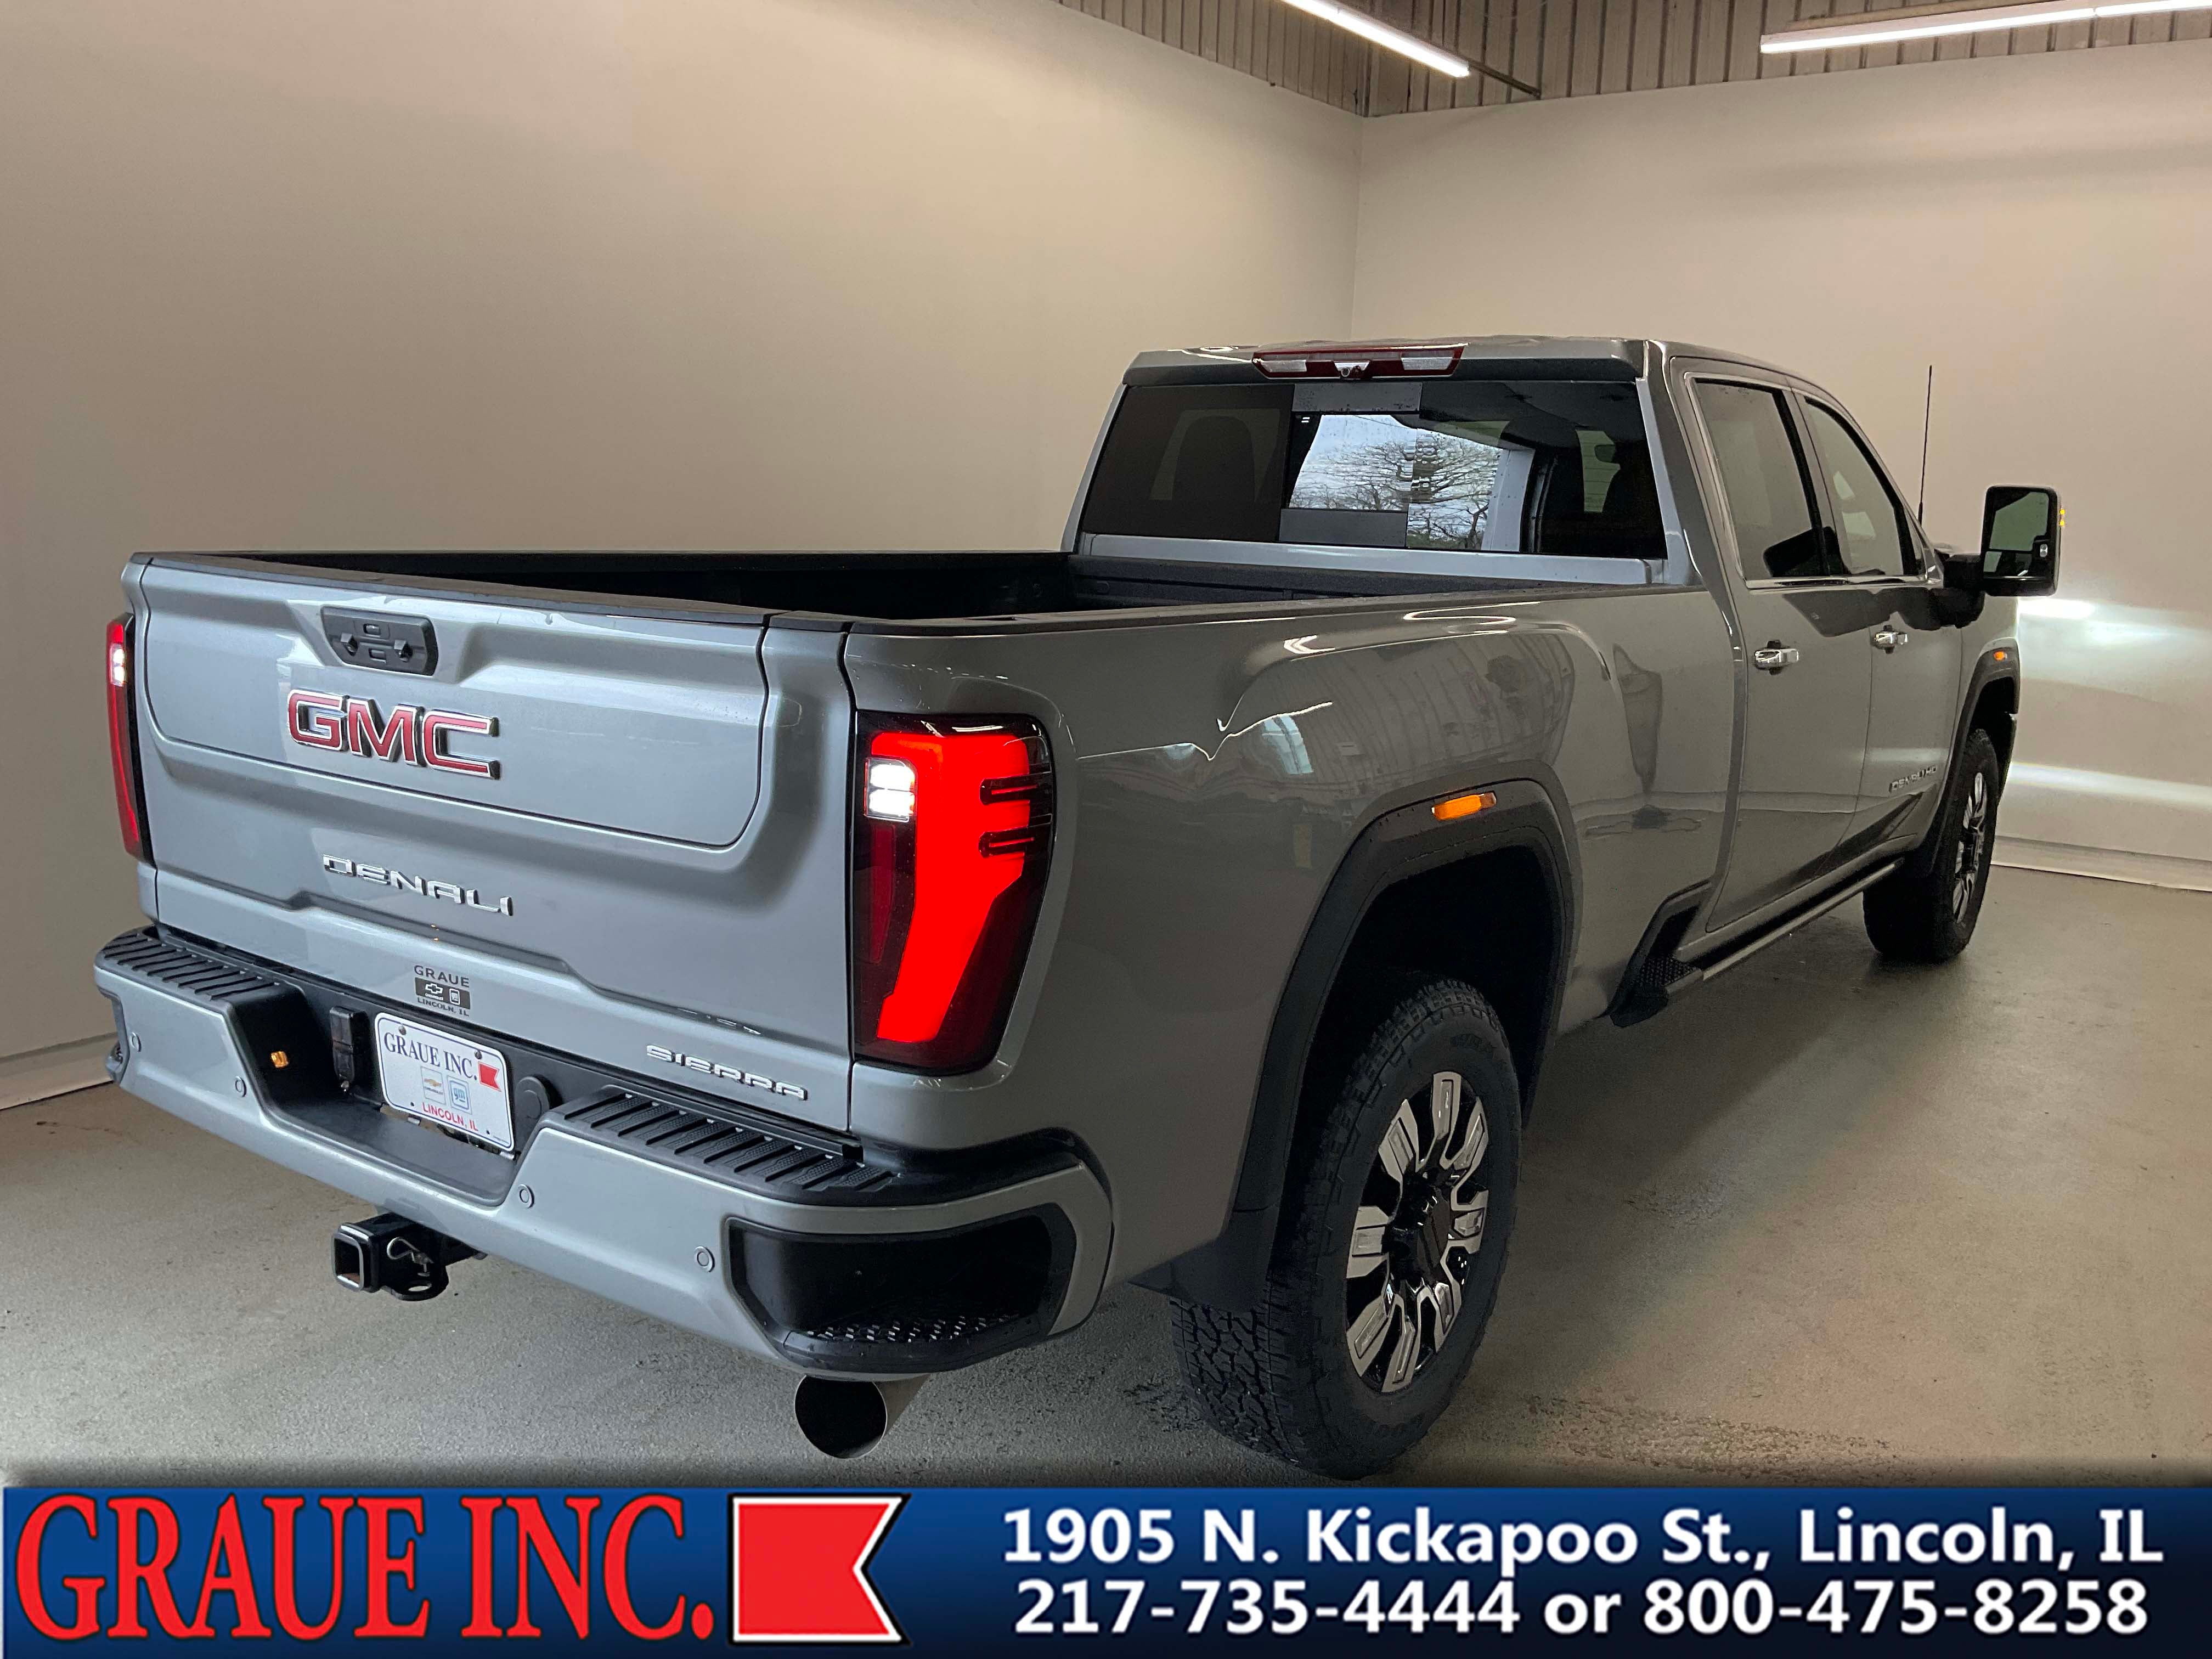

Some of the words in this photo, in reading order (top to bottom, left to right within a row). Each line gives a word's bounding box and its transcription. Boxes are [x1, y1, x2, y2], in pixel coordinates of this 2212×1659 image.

[287, 689, 500, 780] GMC
[323, 854, 514, 916] DENALI
[414, 965, 470, 988] GRAUE
[384, 1032, 440, 1067] GRAUE
[443, 1049, 477, 1081] INC.
[646, 1044, 808, 1101] SIERRA
[469, 1119, 479, 1132] IL
